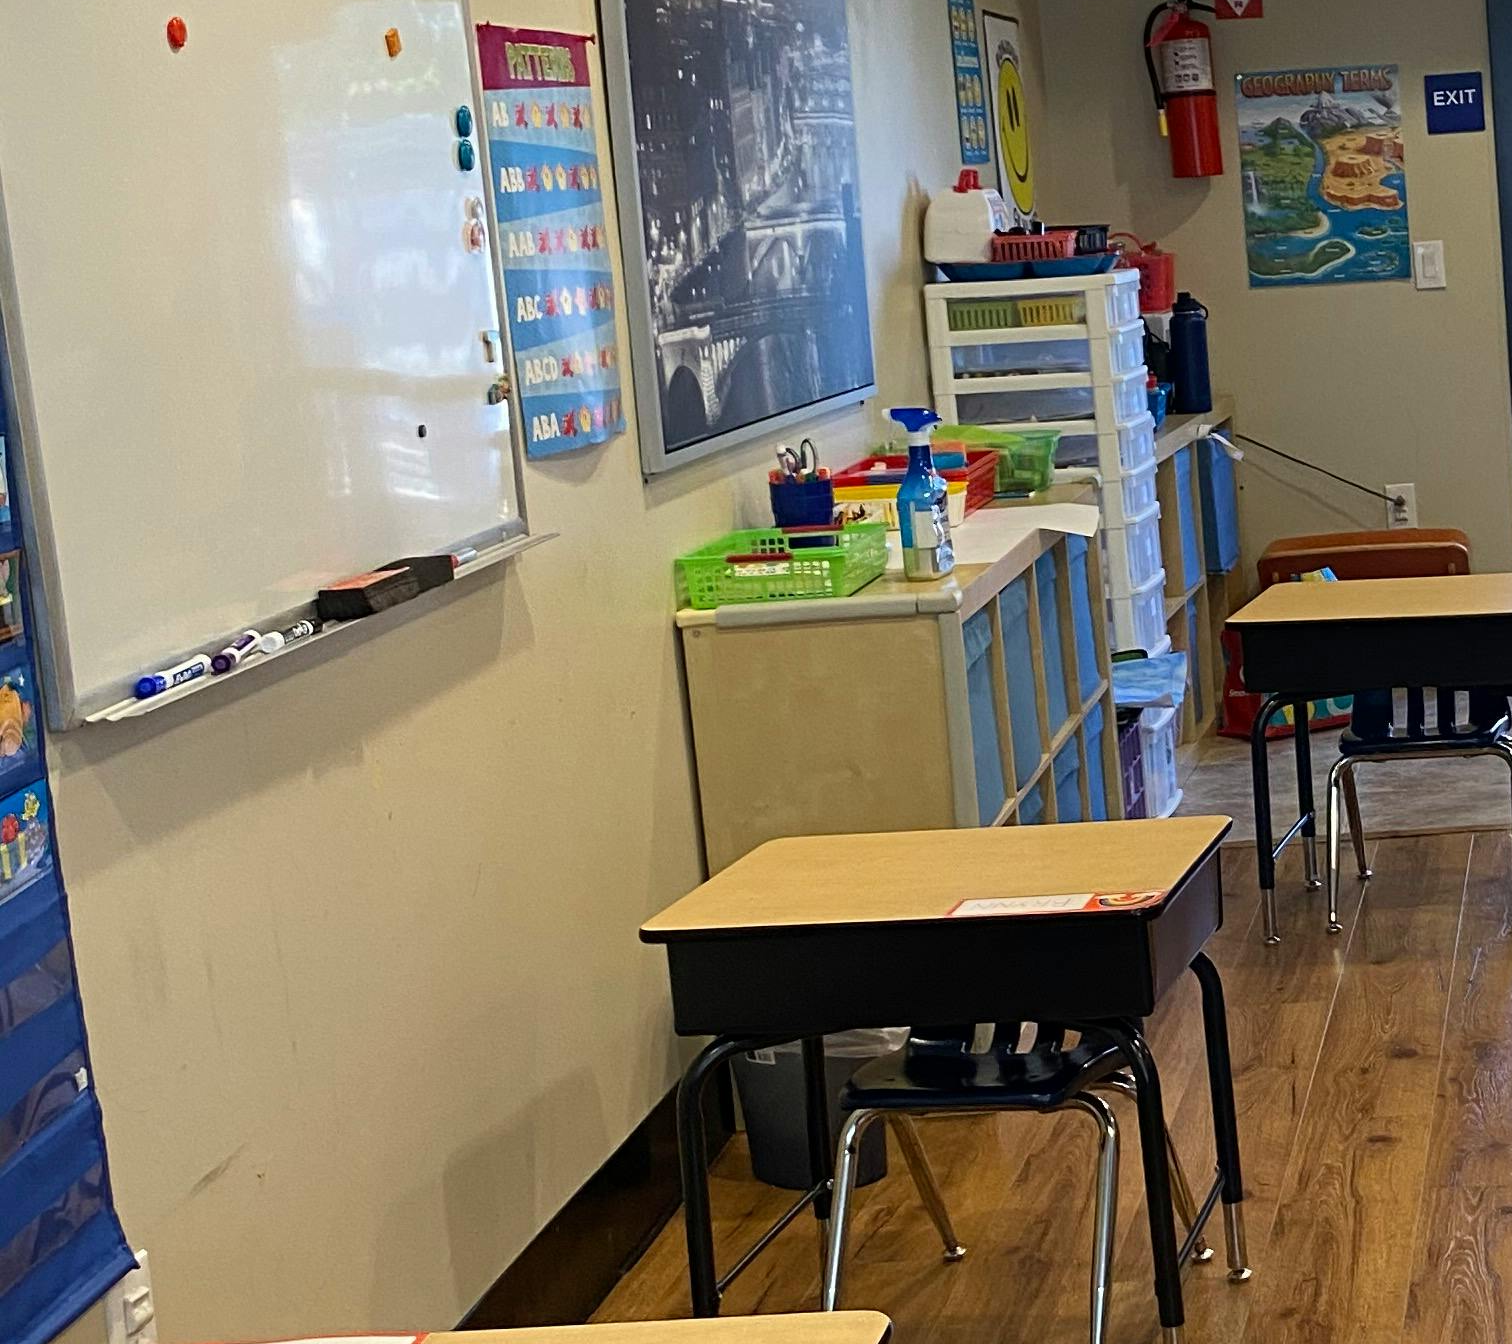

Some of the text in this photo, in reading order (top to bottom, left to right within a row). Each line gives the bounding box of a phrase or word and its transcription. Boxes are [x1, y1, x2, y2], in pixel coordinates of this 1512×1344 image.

[505, 42, 575, 83] PATTERNS
[1340, 67, 1393, 92] TERMS
[1433, 89, 1477, 106] EXIT
[492, 101, 509, 128] AB
[500, 167, 526, 193] ABB
[508, 231, 535, 258] AAB
[516, 294, 544, 324] ABC
[524, 355, 558, 386] ABCD
[532, 412, 561, 443] ABA
